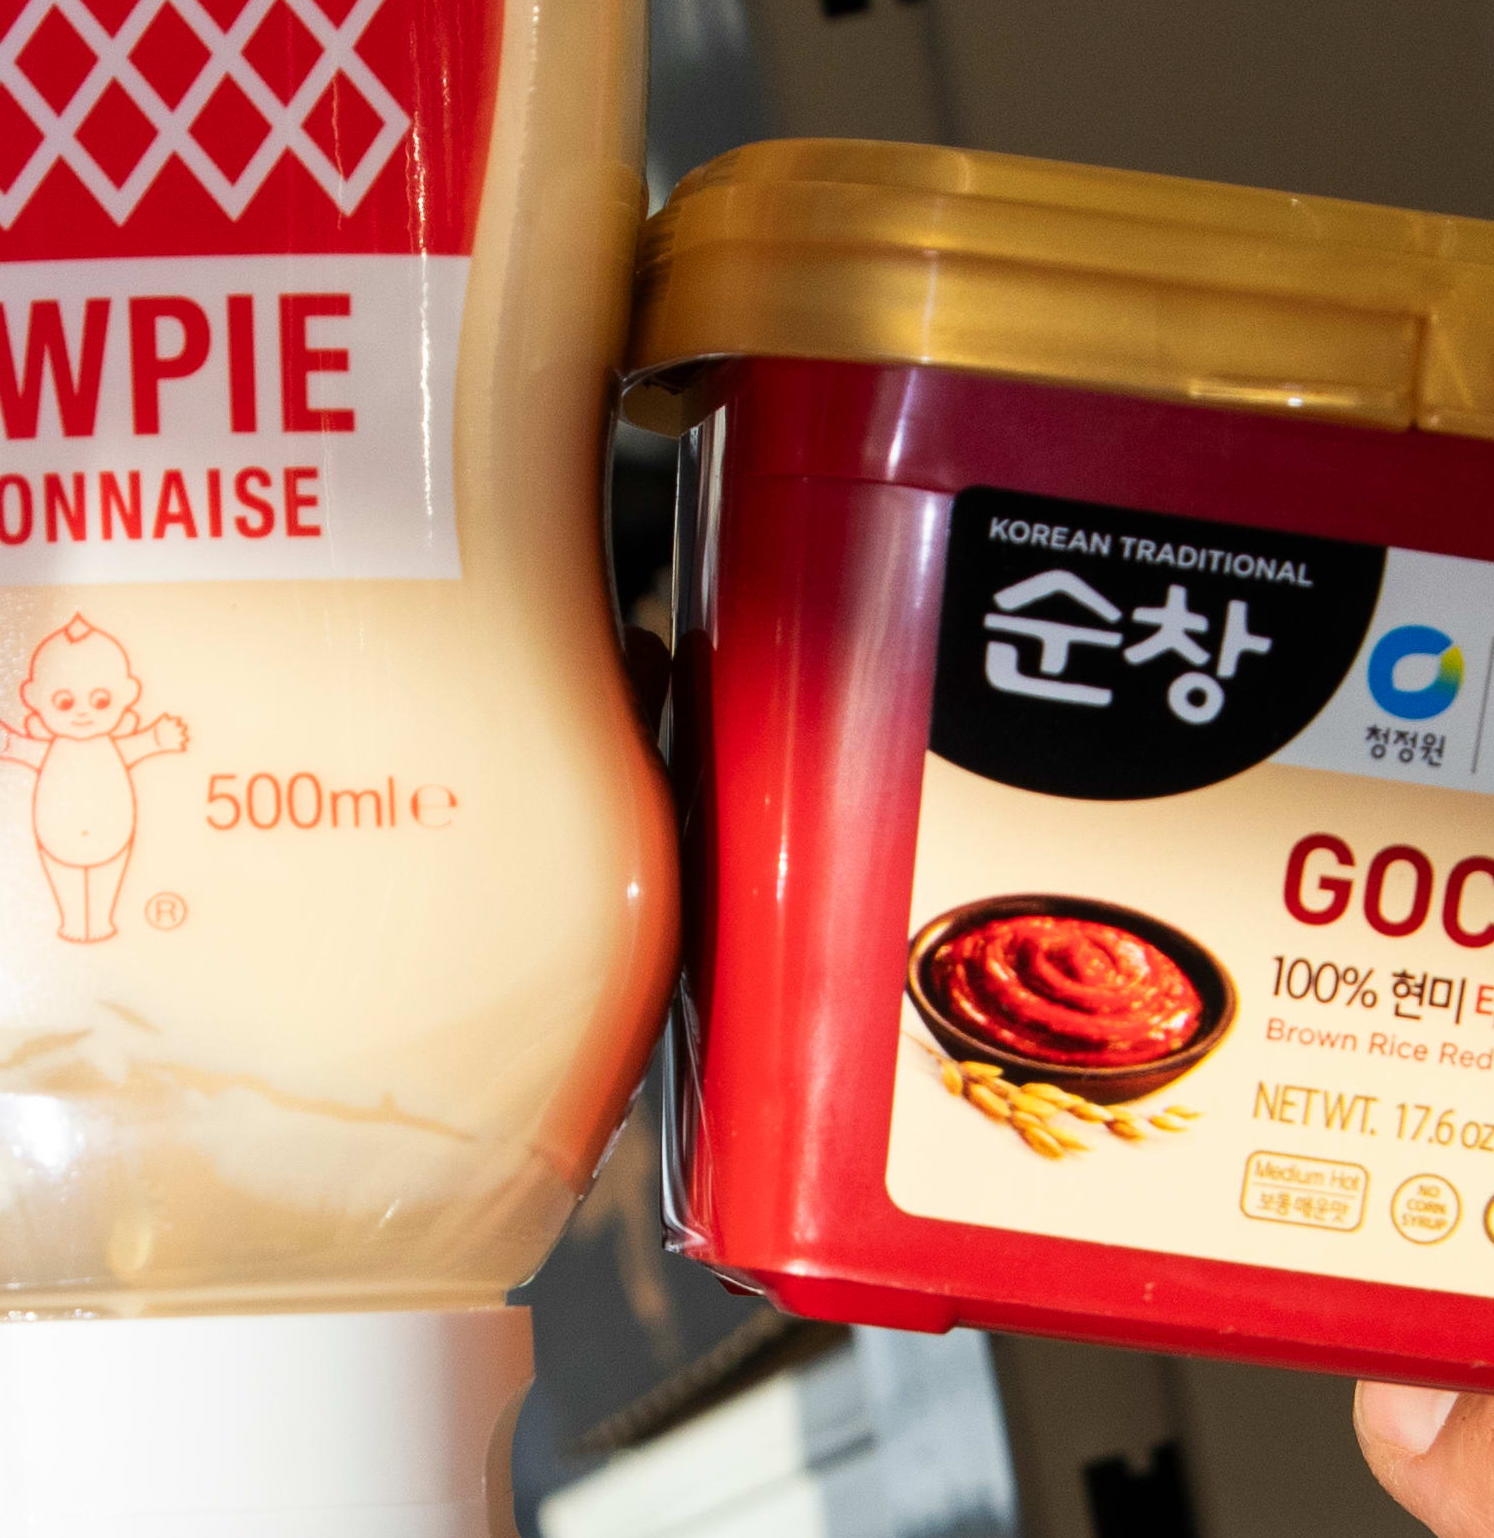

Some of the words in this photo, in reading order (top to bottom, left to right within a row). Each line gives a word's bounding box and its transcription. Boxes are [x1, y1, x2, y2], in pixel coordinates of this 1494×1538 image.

[988, 516, 1113, 556] KOREAN
[1119, 535, 1315, 588] TRADITIONAL
[983, 568, 1273, 726] 순창
[1365, 723, 1446, 768] 청정원
[205, 771, 398, 832] 500ml
[1272, 955, 1378, 1009] 100%
[1391, 968, 1467, 1025] 현미
[1265, 1017, 1358, 1051] Brown
[1367, 1031, 1429, 1062] Rice
[1438, 1041, 1494, 1071] Red
[1395, 1102, 1456, 1147] 17.6
[1255, 1161, 1324, 1186] Medium
[1331, 1171, 1359, 1192] Hot
